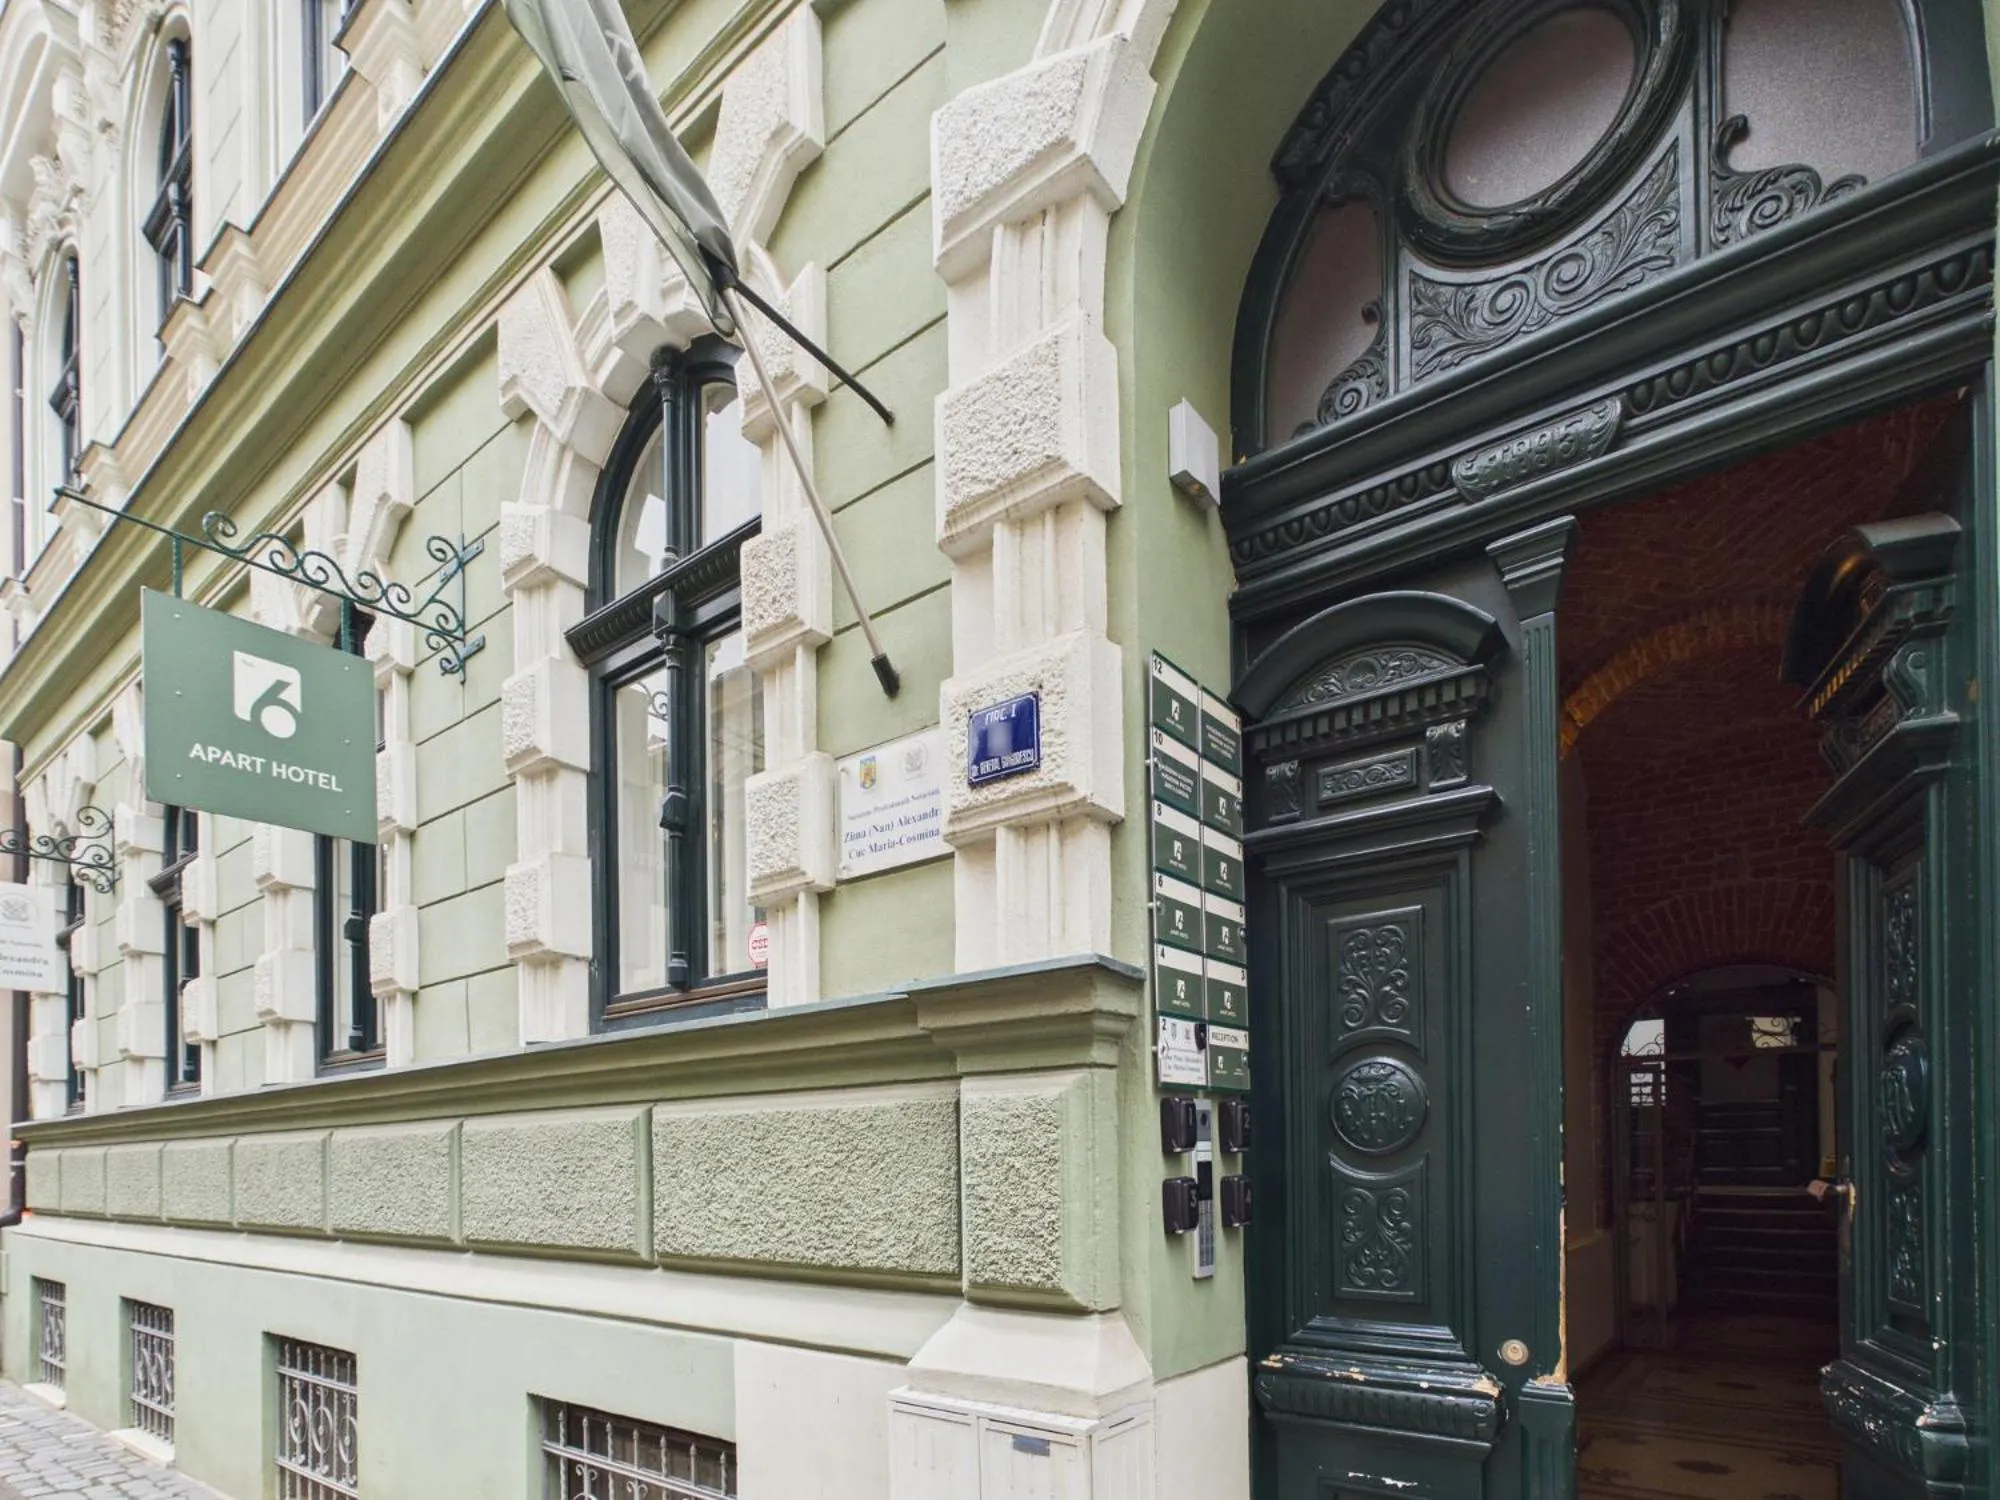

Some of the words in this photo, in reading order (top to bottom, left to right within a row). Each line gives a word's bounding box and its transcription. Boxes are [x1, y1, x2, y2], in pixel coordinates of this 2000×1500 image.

[1153, 658, 1163, 674] 12
[1154, 731, 1164, 745] 10
[189, 742, 267, 774] APART
[271, 760, 343, 792] HOTEL
[898, 807, 942, 827] Alexandr
[1157, 875, 1164, 887] 6
[1161, 1018, 1167, 1031] 2
[1243, 1112, 1251, 1130] 2
[1190, 1188, 1198, 1208] 3
